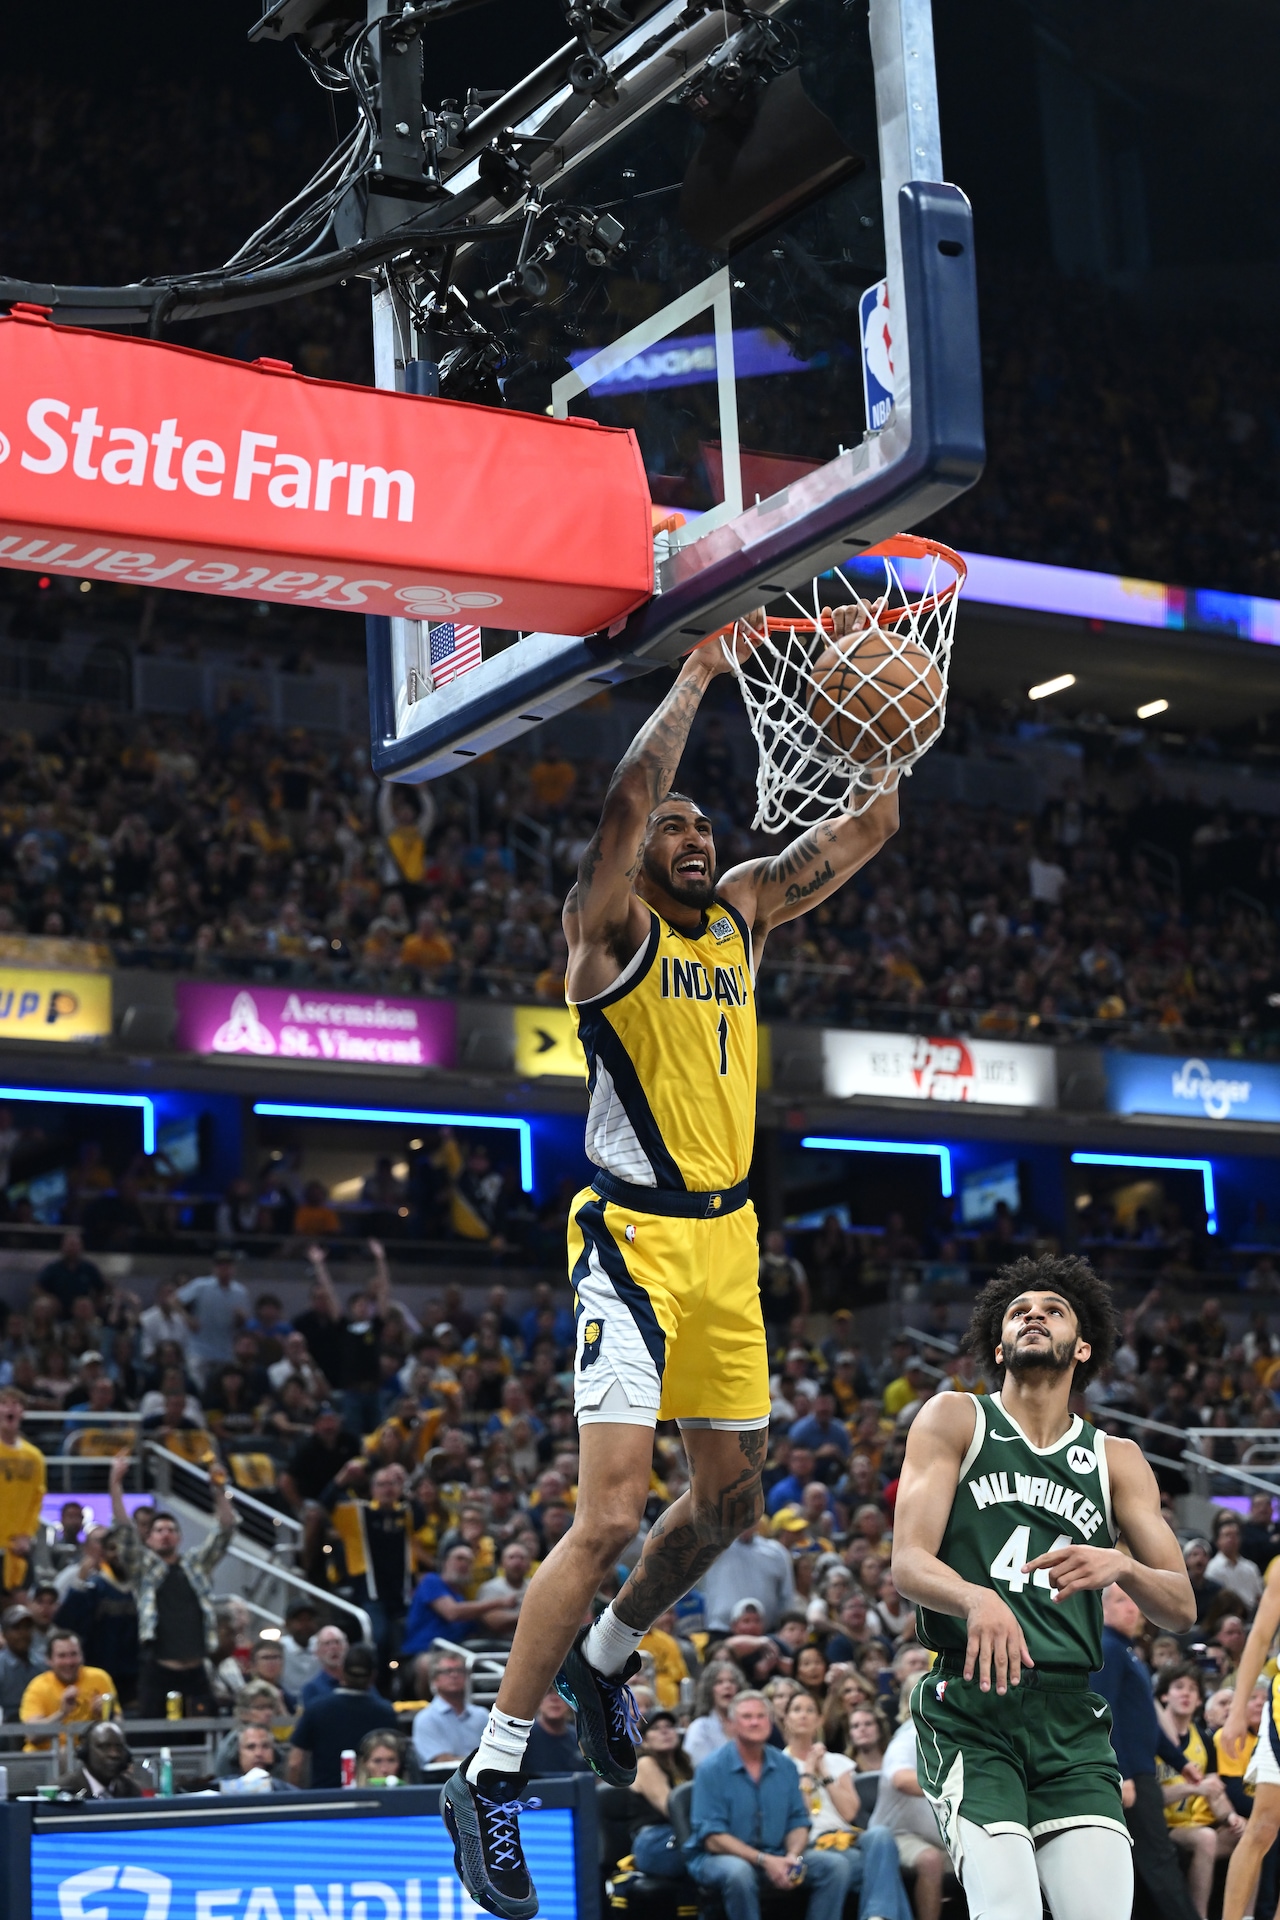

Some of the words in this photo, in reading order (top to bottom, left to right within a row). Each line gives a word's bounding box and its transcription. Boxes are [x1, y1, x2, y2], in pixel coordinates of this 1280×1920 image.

[872, 397, 892, 429] NBA
[785, 860, 836, 906] Daniel
[280, 993, 418, 1032] Ascension
[279, 1025, 319, 1057] St.
[316, 1027, 423, 1064] Vincent
[716, 1012, 729, 1075] 1
[1172, 1058, 1252, 1119] Kroger
[968, 1472, 1104, 1541] MILWAUKEE
